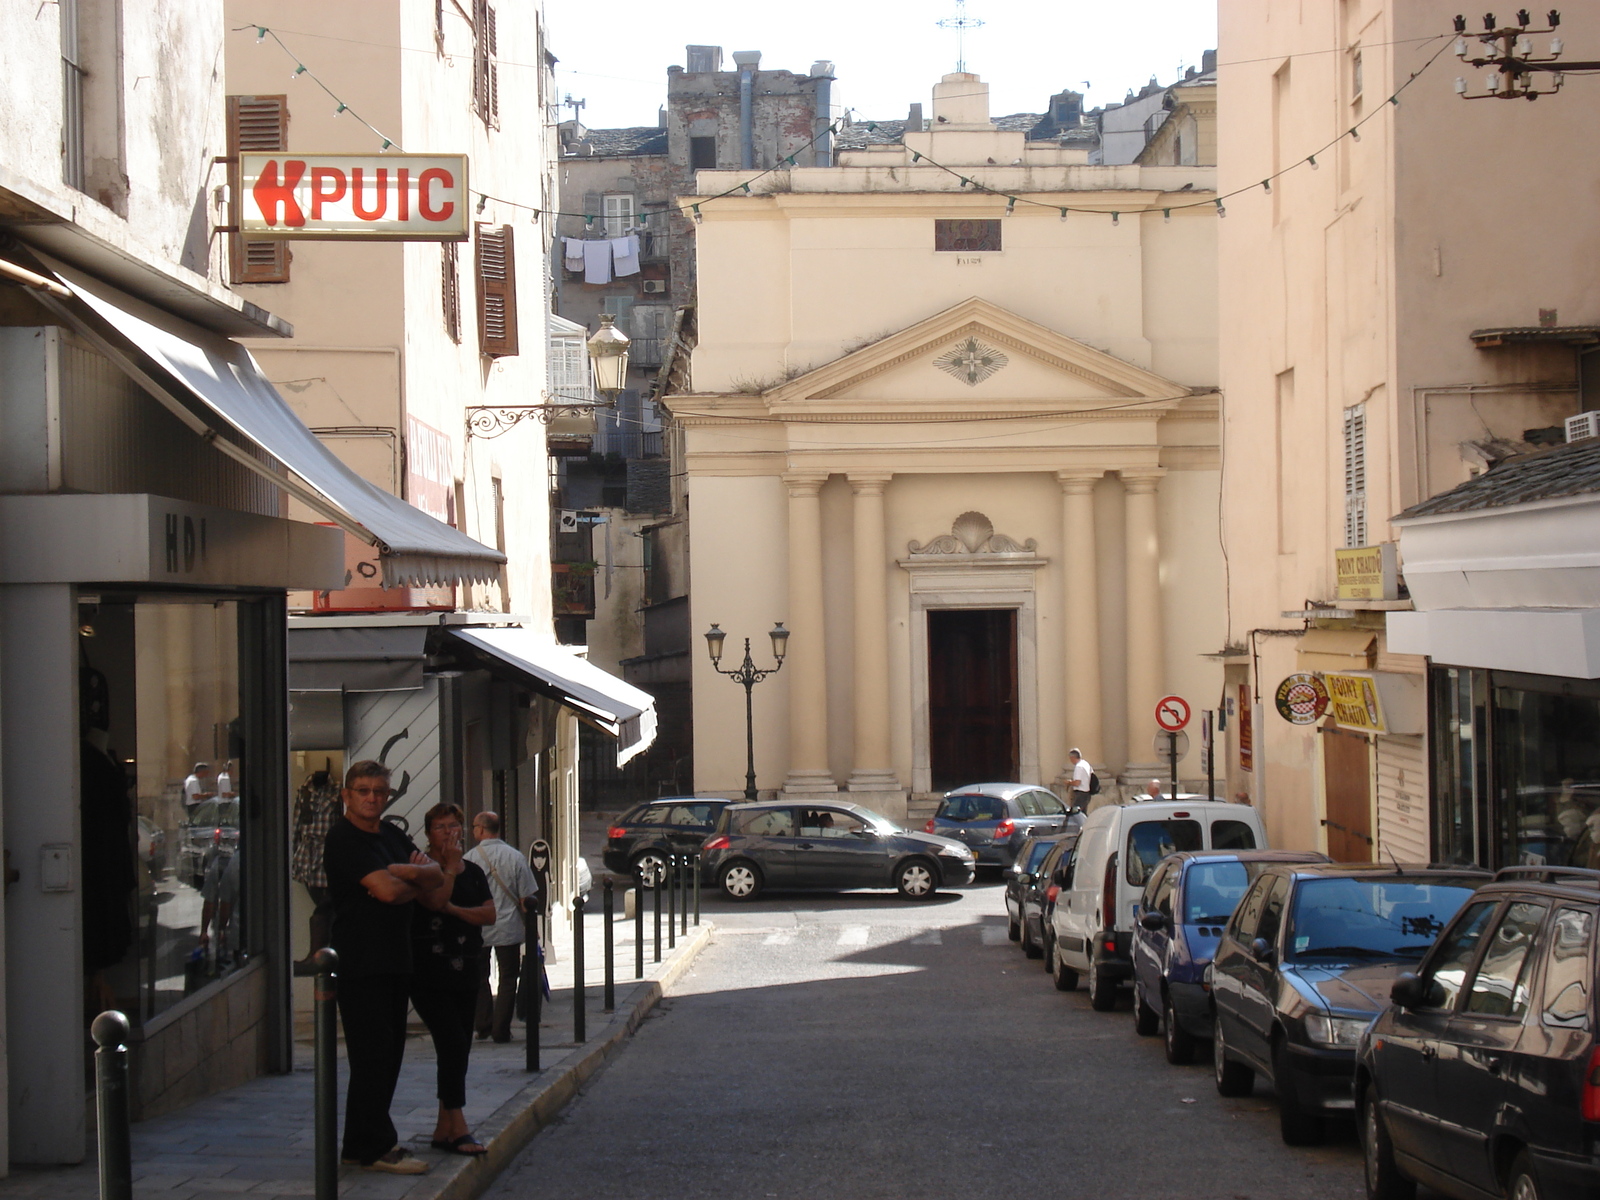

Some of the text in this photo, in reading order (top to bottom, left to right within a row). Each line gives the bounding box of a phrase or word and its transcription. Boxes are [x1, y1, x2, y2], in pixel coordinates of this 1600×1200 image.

[1337, 555, 1377, 575] POINT CHAUD
[1278, 678, 1297, 700] PIZZA
[1330, 677, 1359, 699] POINT
[1335, 702, 1367, 726] CHAUD
